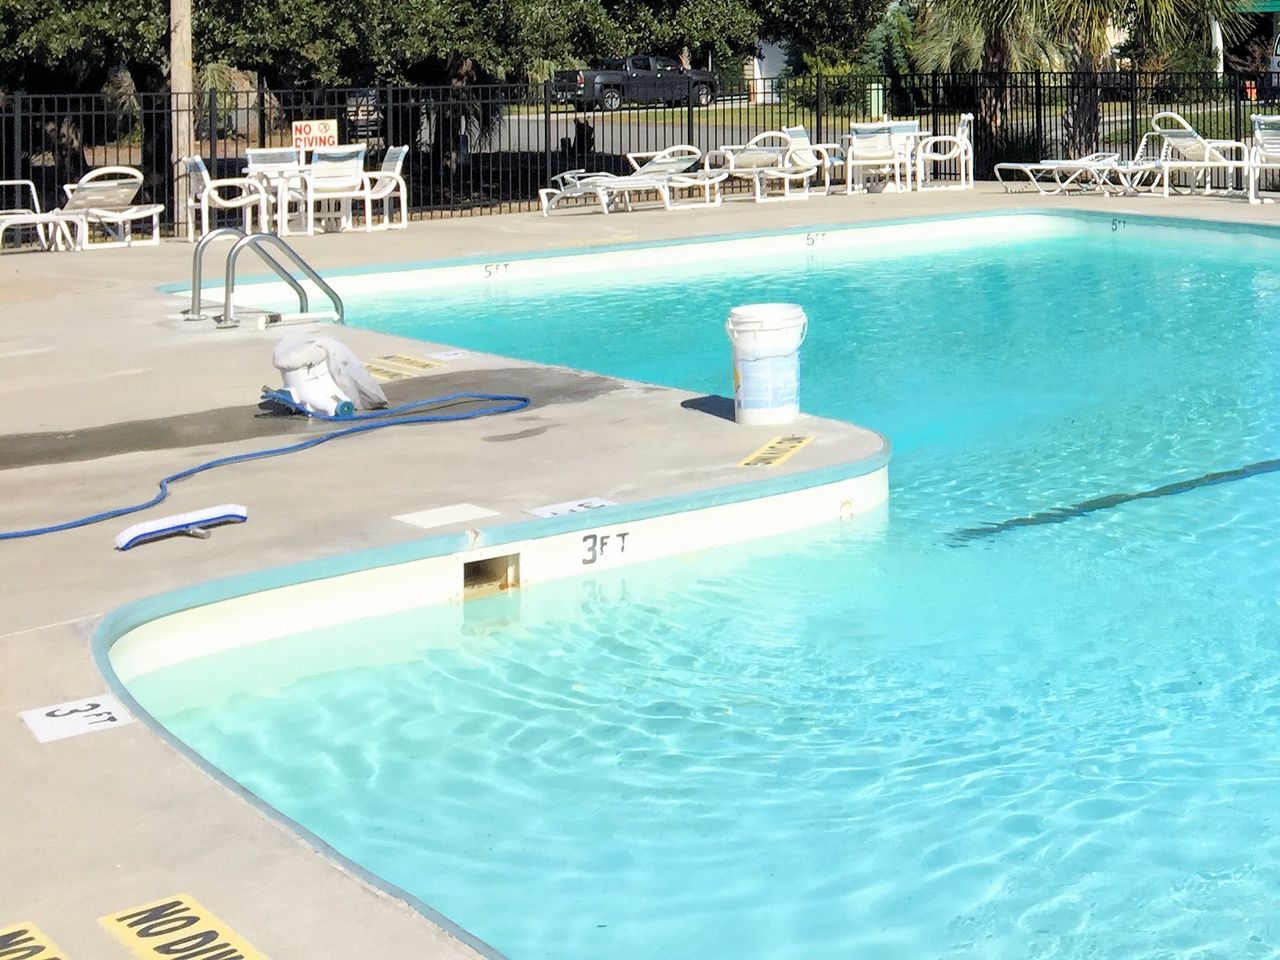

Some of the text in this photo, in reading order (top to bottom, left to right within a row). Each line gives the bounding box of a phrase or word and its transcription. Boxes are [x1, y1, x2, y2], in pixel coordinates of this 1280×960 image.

[294, 124, 312, 136] NO
[294, 136, 336, 148] DIVING
[582, 532, 630, 565] 3FT
[115, 900, 201, 938] NO
